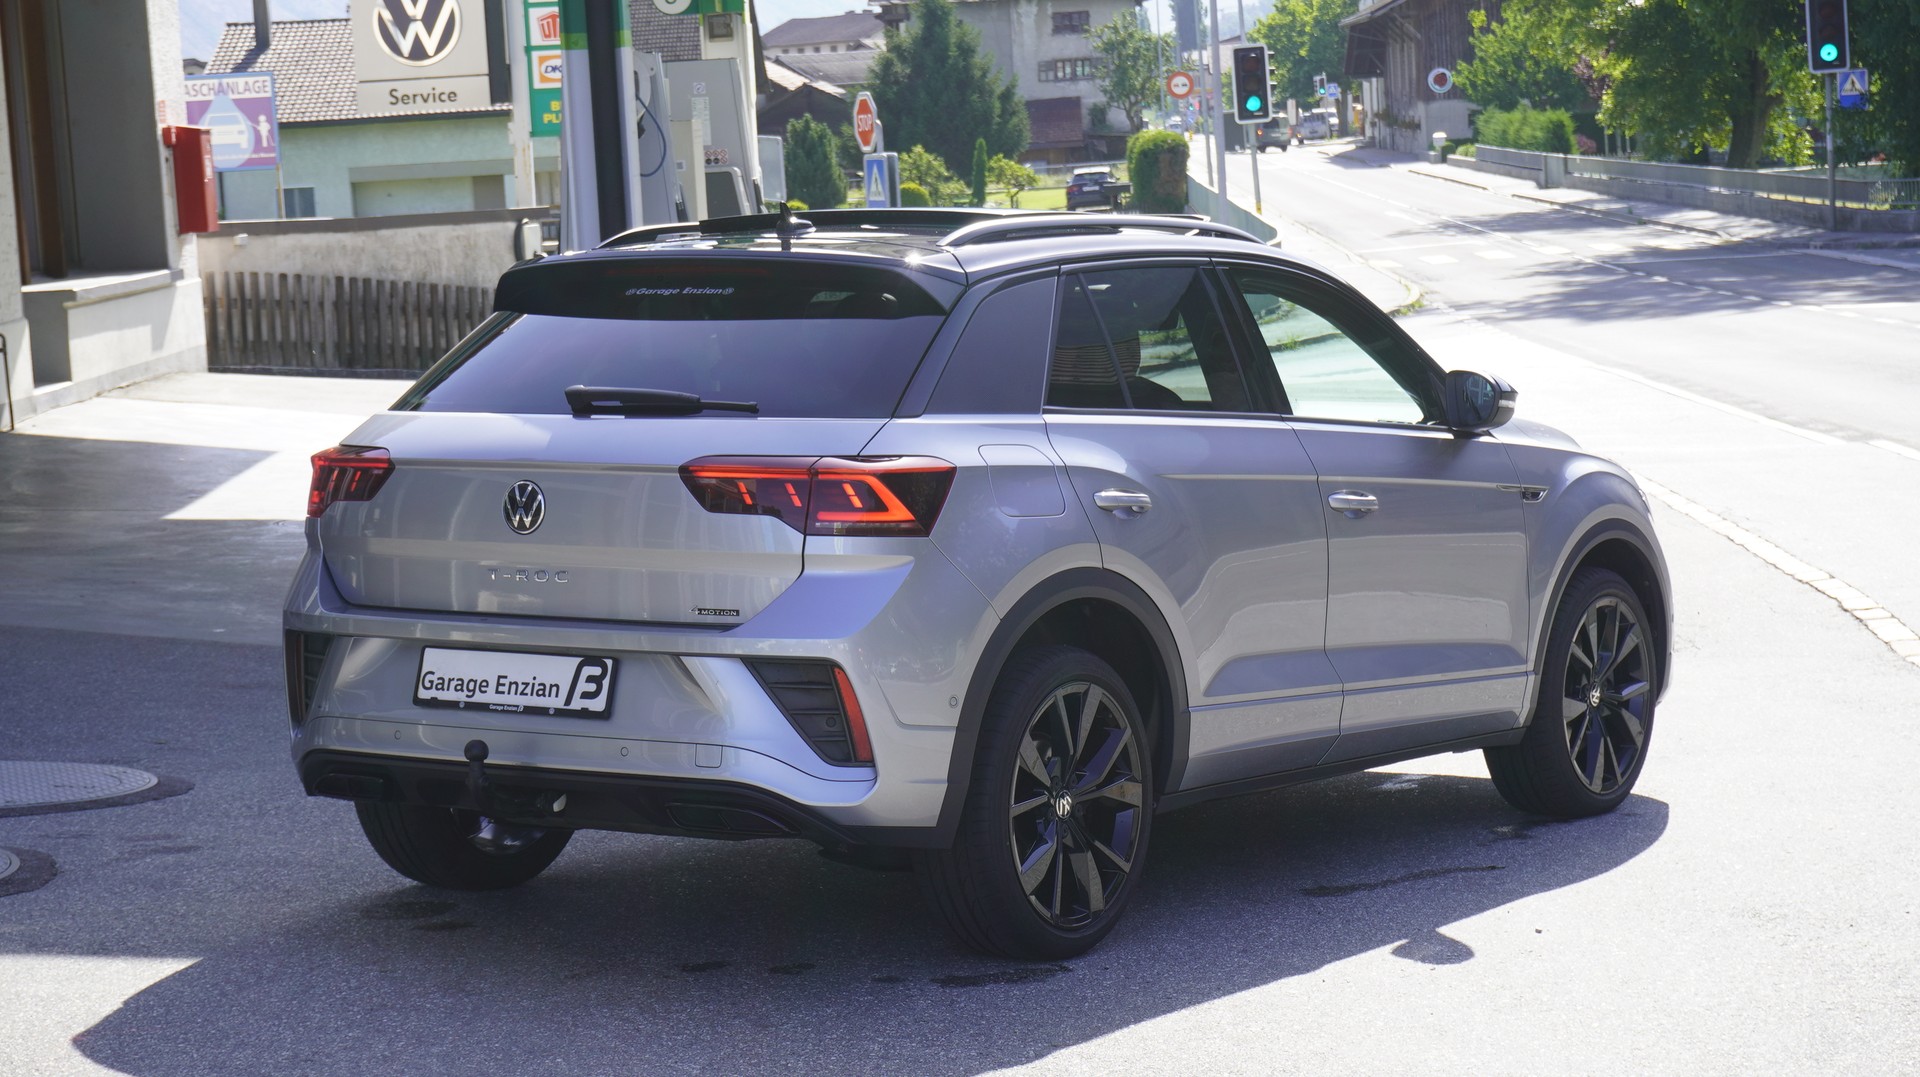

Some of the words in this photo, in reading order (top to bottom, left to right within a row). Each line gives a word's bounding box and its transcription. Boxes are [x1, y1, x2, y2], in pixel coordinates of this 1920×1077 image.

[545, 65, 562, 74] DK
[184, 79, 270, 98] ASCHANLAGE
[389, 87, 458, 105] Service
[550, 100, 560, 111] B
[543, 113, 561, 124] PLU
[858, 114, 872, 131] STOP
[636, 287, 679, 296] Garage
[682, 287, 722, 295] Enzian
[488, 569, 568, 583] T-ROC
[421, 671, 489, 698] Garage
[494, 675, 560, 698] Enzian
